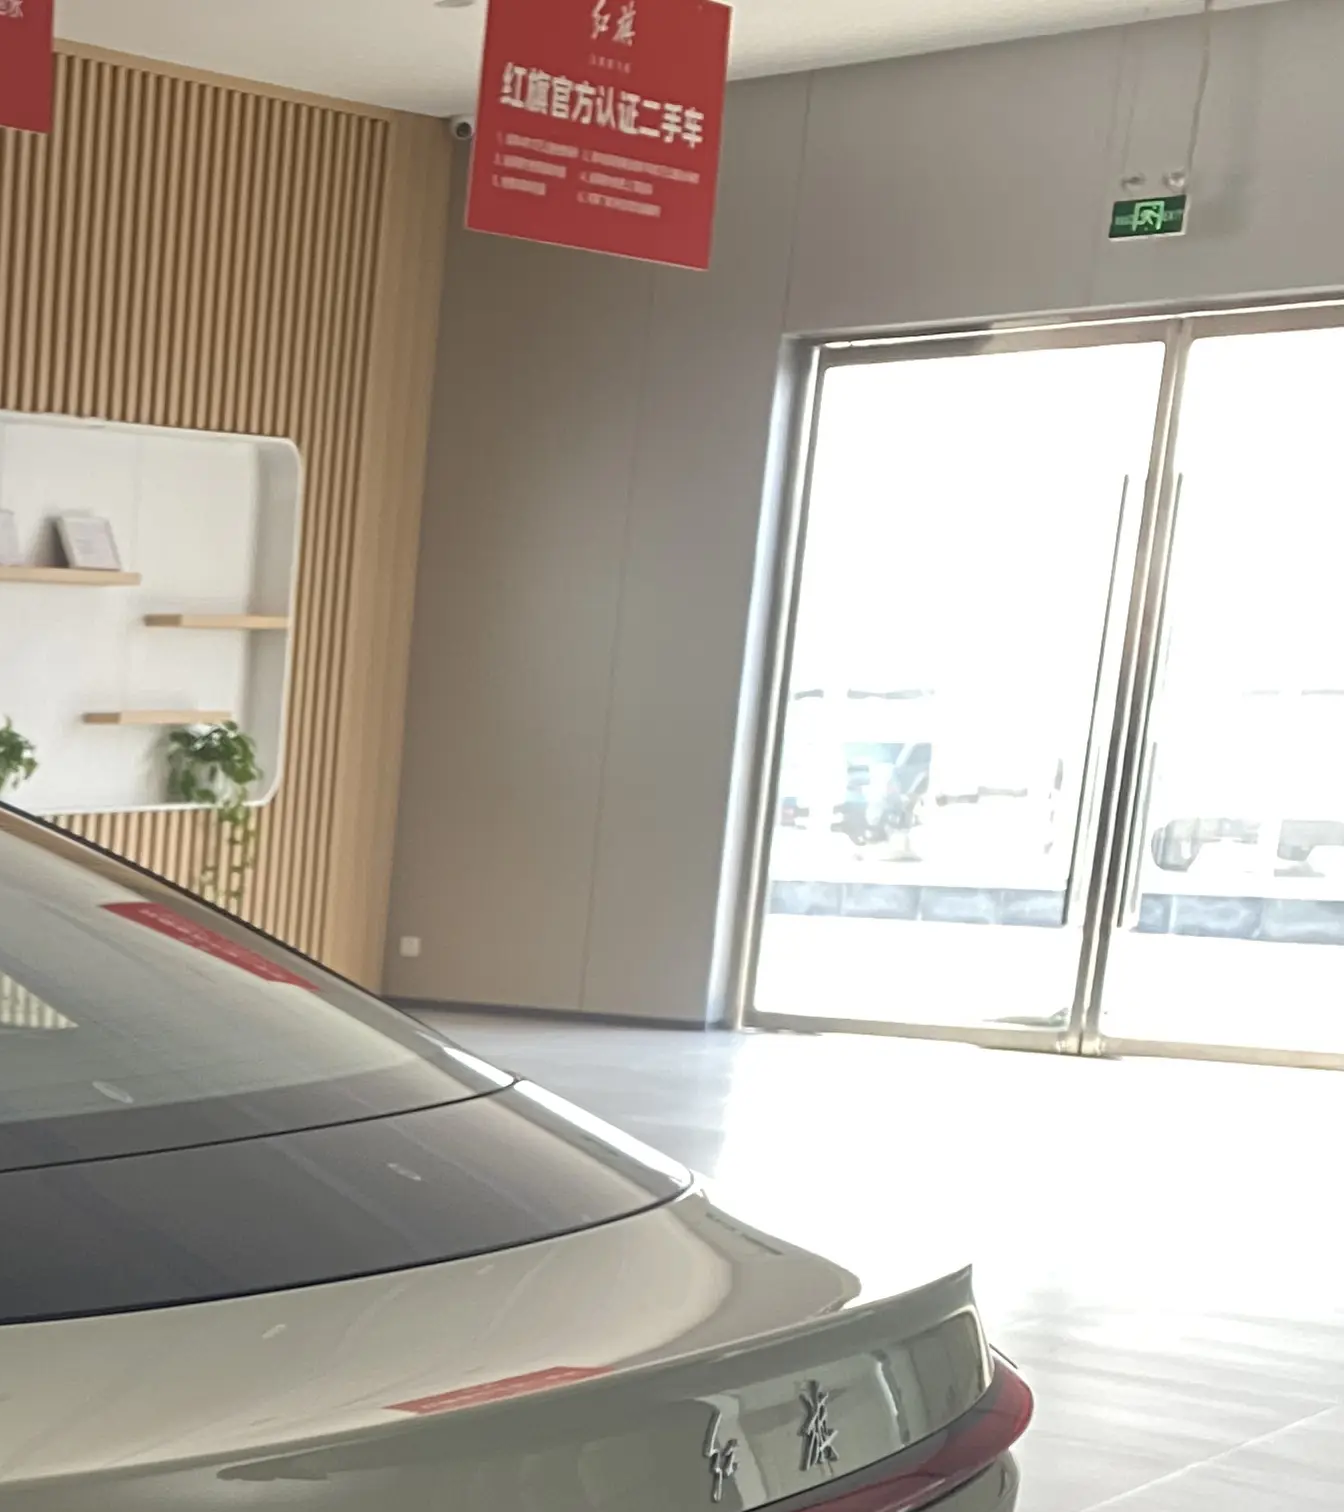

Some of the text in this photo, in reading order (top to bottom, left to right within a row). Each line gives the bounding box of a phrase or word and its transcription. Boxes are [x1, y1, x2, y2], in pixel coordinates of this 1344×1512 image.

[500, 62, 705, 149] 红旗官方认证二手车
